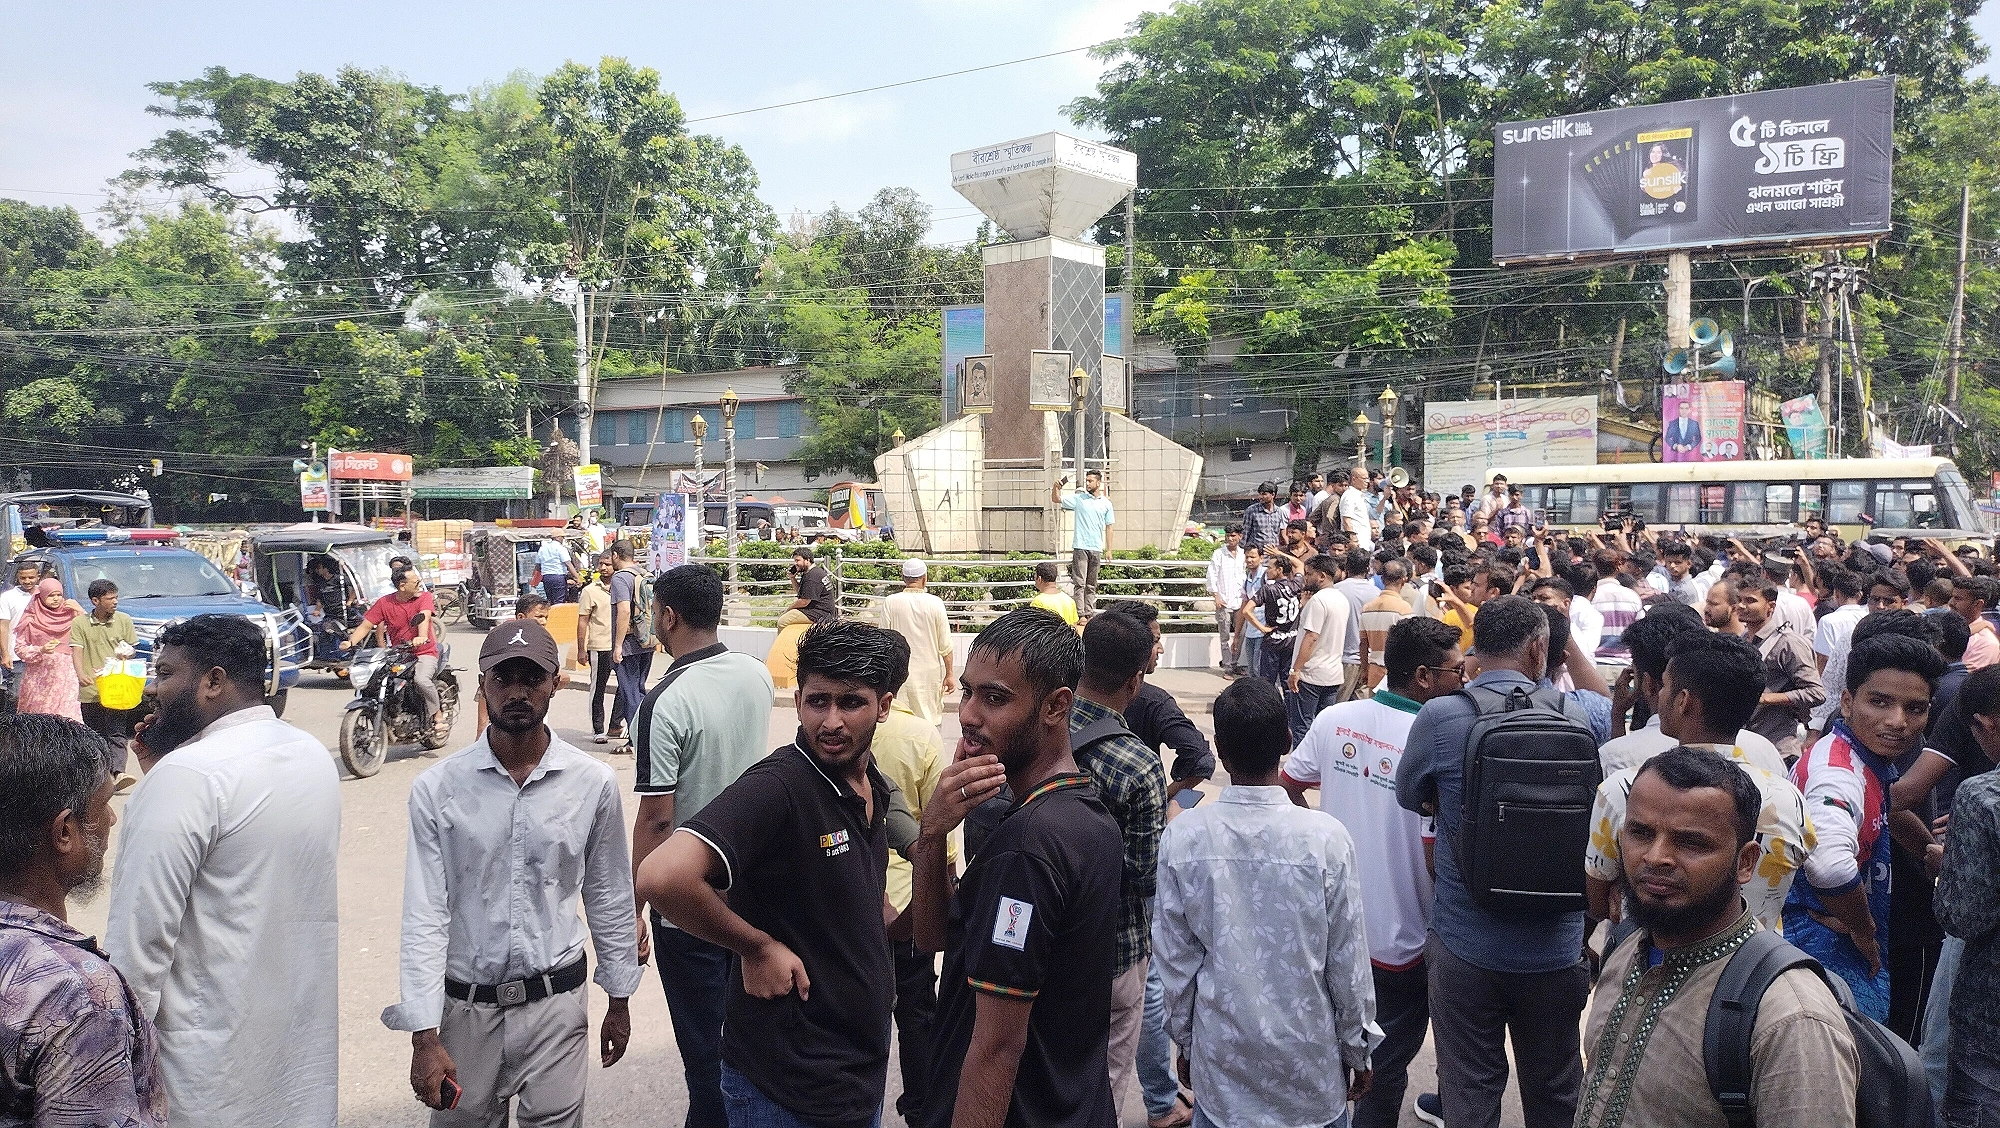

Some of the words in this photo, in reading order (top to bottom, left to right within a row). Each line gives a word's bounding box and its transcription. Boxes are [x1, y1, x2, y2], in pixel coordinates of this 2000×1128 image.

[1502, 119, 1574, 145] sunsilk
[1729, 115, 1757, 148] ৫
[1760, 120, 1777, 139] টি
[1779, 119, 1831, 137] কিনলে
[1783, 143, 1805, 168] টি
[1811, 143, 1840, 166] ফ্রি
[1639, 171, 1688, 188] sunsilk
[1748, 182, 1805, 200] ঝলমলে
[1806, 178, 1844, 195] শাইন
[1745, 200, 1773, 214] এখন
[1276, 596, 1300, 624] 30
